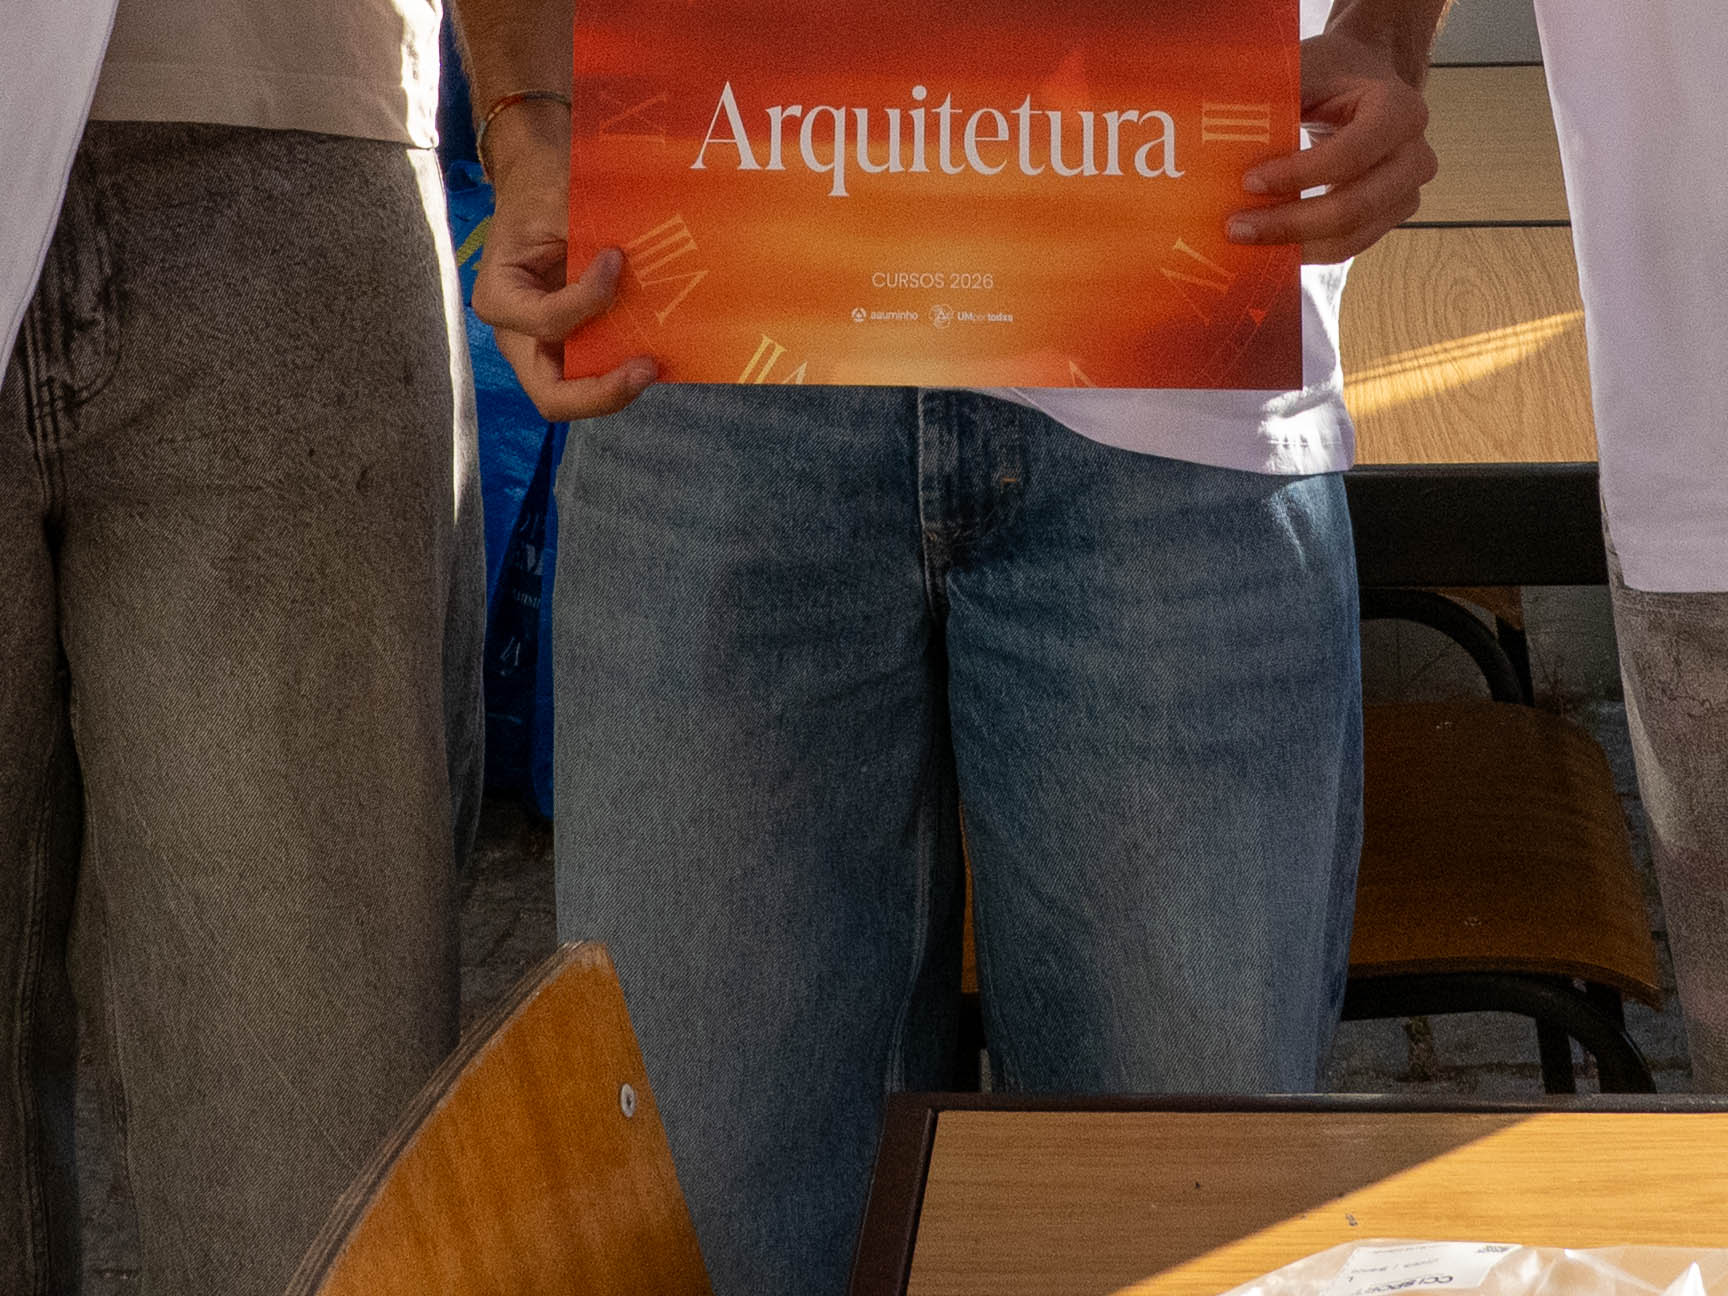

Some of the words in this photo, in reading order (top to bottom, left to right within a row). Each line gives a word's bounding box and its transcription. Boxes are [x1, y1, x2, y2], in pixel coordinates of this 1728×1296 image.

[689, 80, 1185, 197] Arquitetura
[872, 272, 945, 289] CURSOS
[950, 272, 995, 290] 2026
